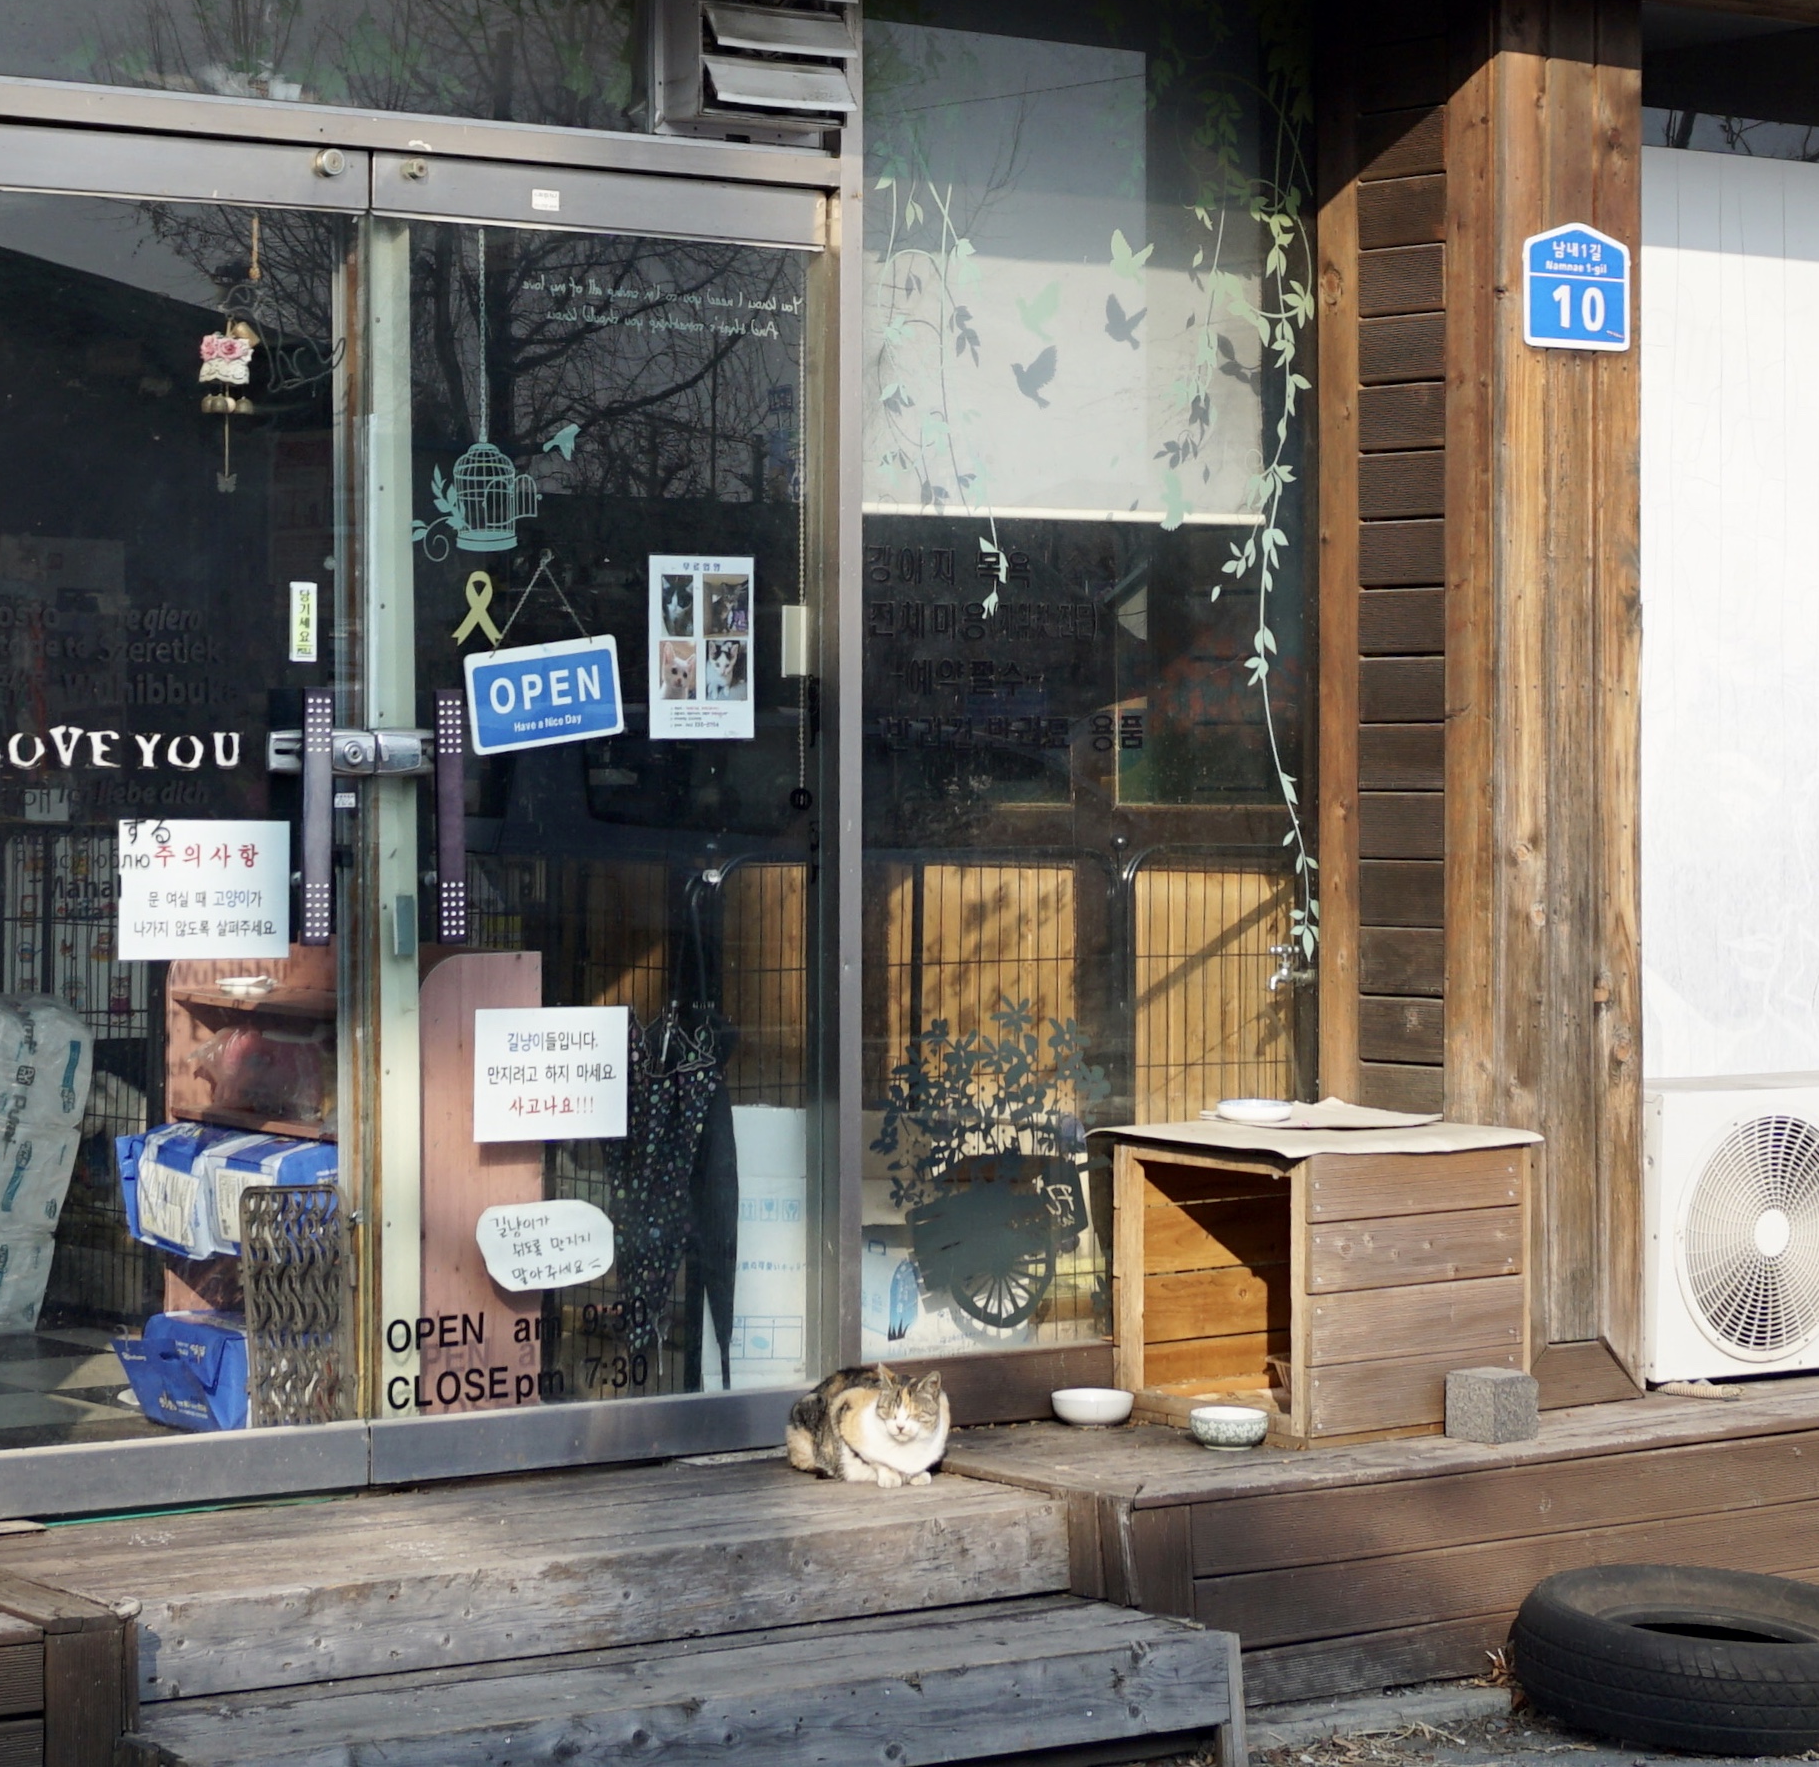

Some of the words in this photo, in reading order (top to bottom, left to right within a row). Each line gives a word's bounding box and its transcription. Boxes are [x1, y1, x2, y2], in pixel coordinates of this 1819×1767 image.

[1553, 241, 1601, 261] 남내1길
[1545, 260, 1584, 272] Namnae
[1586, 263, 1607, 276] 1-gil
[1552, 284, 1605, 332] 10
[866, 546, 955, 585] 강아지
[299, 589, 310, 643] 당기세요
[489, 664, 601, 715] OPEN
[514, 720, 537, 733] Have
[545, 716, 564, 728] Nice
[565, 714, 582, 726] Day
[1092, 714, 1143, 752] 용품
[132, 730, 243, 770] YOU
[154, 843, 259, 868] 주의사항
[148, 891, 159, 908] 문
[166, 891, 189, 908] 여실
[195, 891, 207, 908] 때
[212, 889, 262, 908] 고양이가
[134, 920, 169, 937] 나가지
[175, 920, 210, 937] 않도록
[507, 1030, 598, 1052] 길냥이들입니다.
[488, 1064, 538, 1085] 만지려고
[545, 1063, 569, 1083] 하지
[509, 1095, 594, 1117] 사고나요!!!
[489, 1215, 550, 1238] 길냥이가
[550, 1233, 591, 1252] 만지지
[386, 1311, 485, 1353] OPEN
[514, 1315, 562, 1343] am
[582, 1296, 648, 1333] 9:30
[387, 1366, 509, 1410] CLOSE
[515, 1369, 564, 1404] pm
[585, 1354, 648, 1390] 7:30
